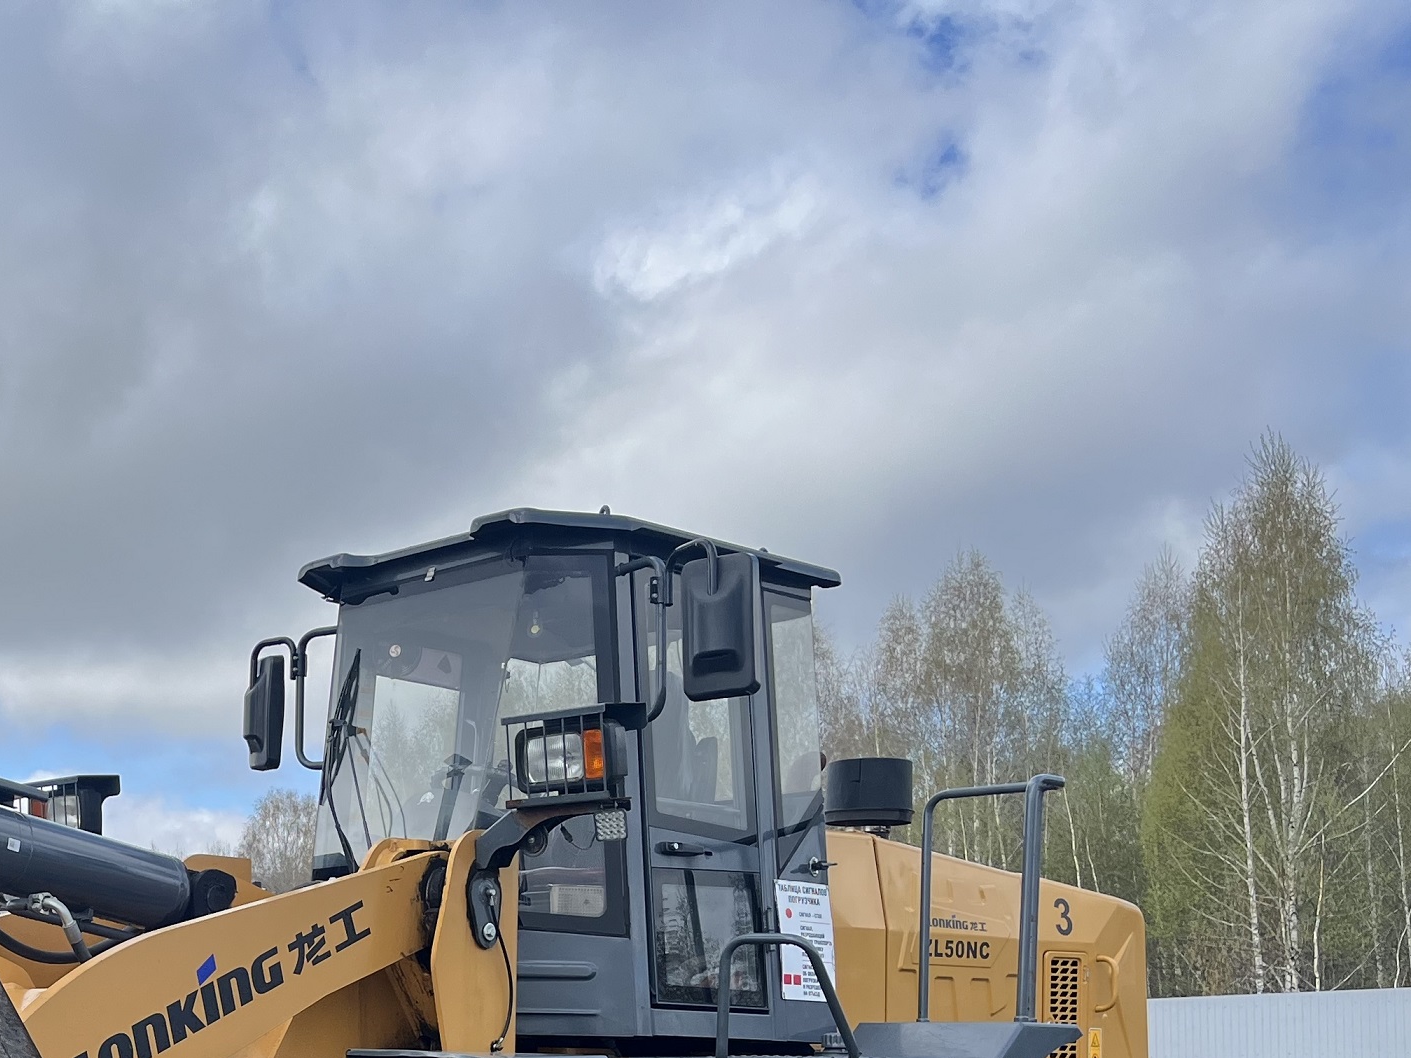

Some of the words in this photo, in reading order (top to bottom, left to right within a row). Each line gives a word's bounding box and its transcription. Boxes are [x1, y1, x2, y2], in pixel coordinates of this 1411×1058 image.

[778, 884, 801, 894] ТАБЛИЦА
[802, 886, 827, 896] СИГНАЛОВ
[788, 896, 820, 906] ПОГРУЗЧИКА
[1053, 898, 1073, 936] 3
[287, 900, 372, 976] 龙工
